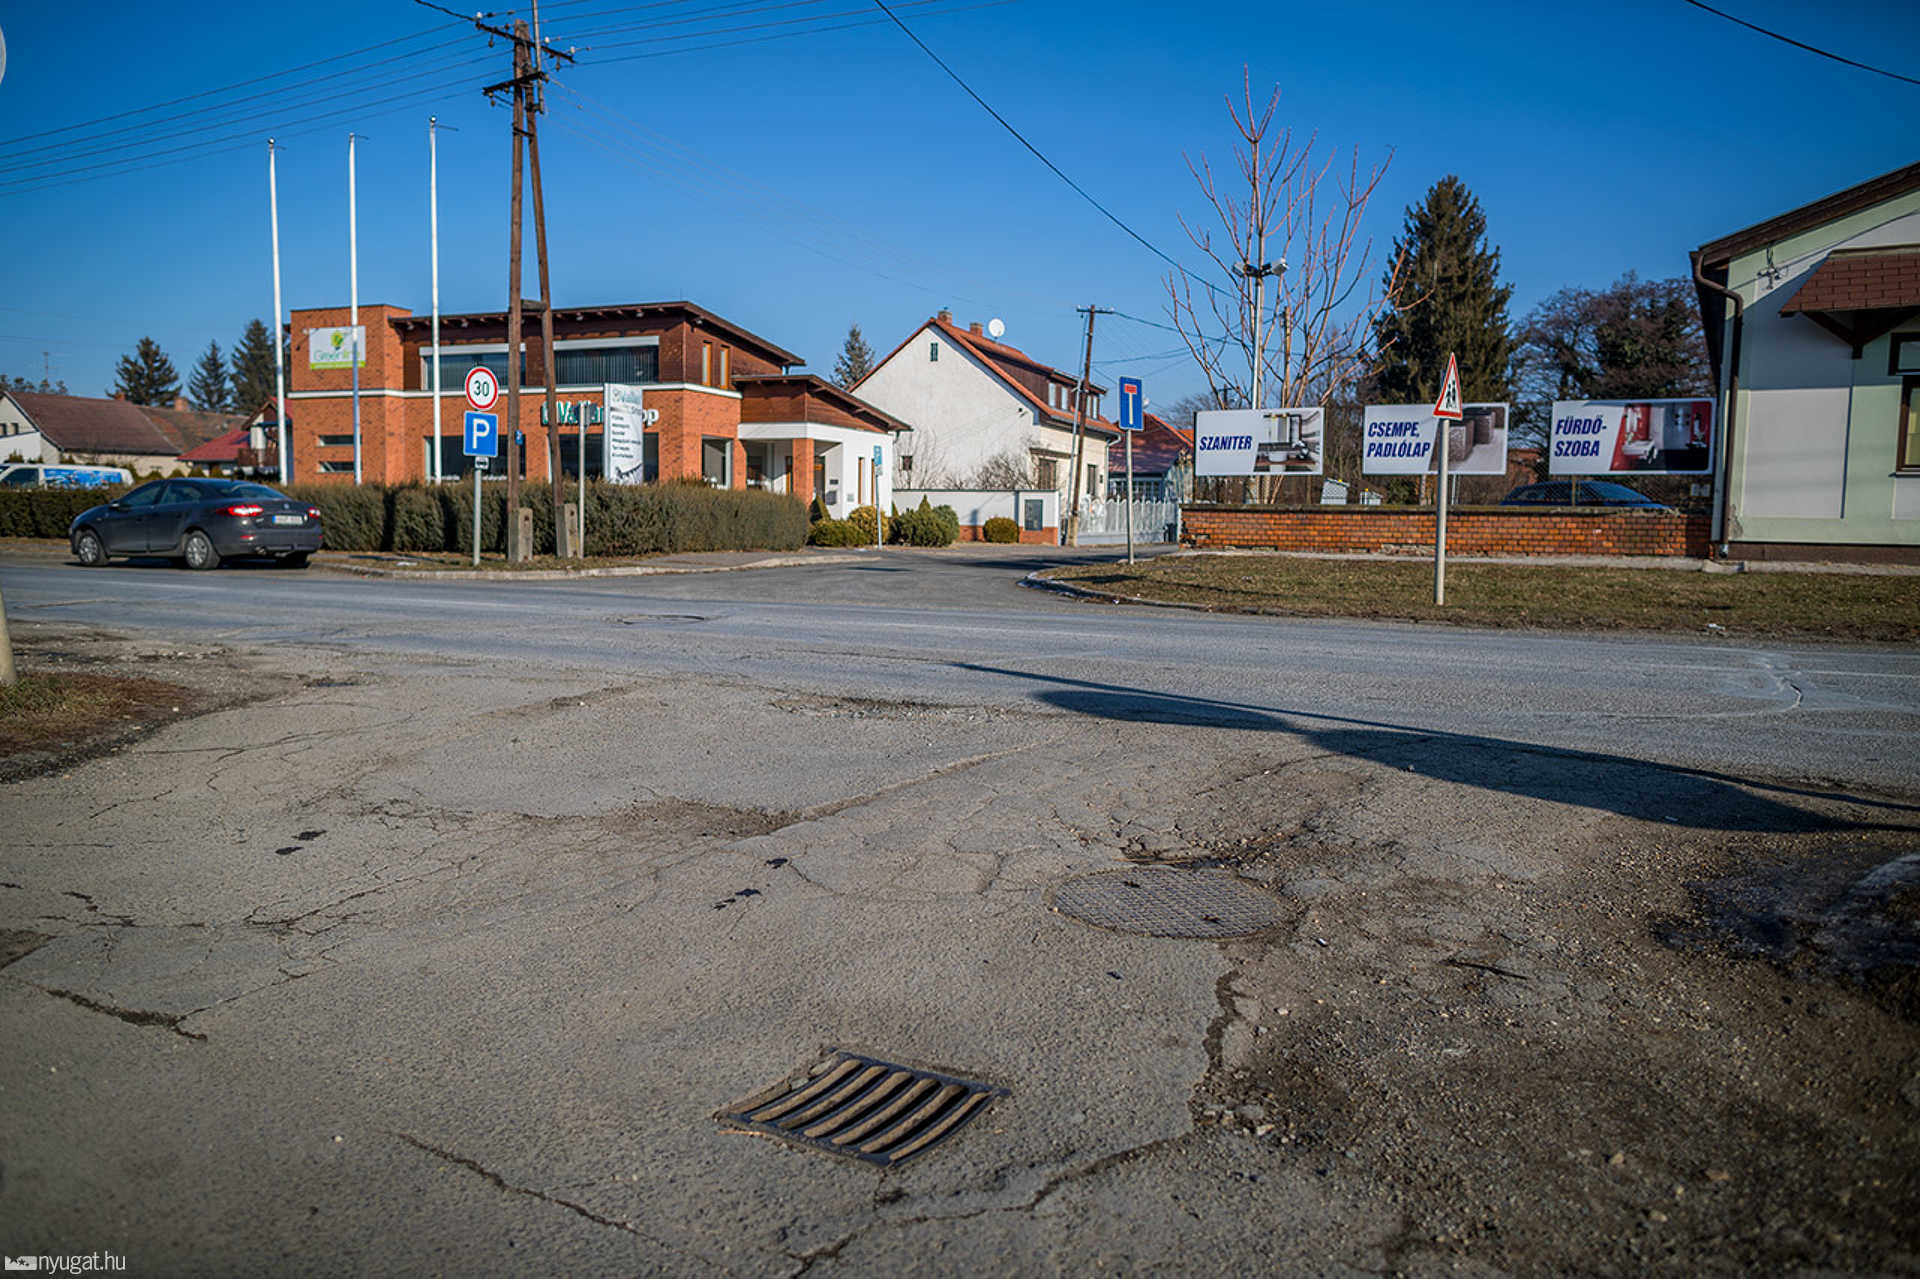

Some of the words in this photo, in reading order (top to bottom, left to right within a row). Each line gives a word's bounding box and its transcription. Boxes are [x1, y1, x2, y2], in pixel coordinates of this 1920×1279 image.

[474, 380, 489, 397] 30
[472, 418, 490, 449] P
[1368, 421, 1420, 438] CSEMPE,
[1555, 414, 1607, 435] FÜRDŐ-
[1199, 435, 1253, 451] SZANITER
[1367, 440, 1431, 458] PADLÓLAP
[1554, 439, 1600, 457] SZOBA
